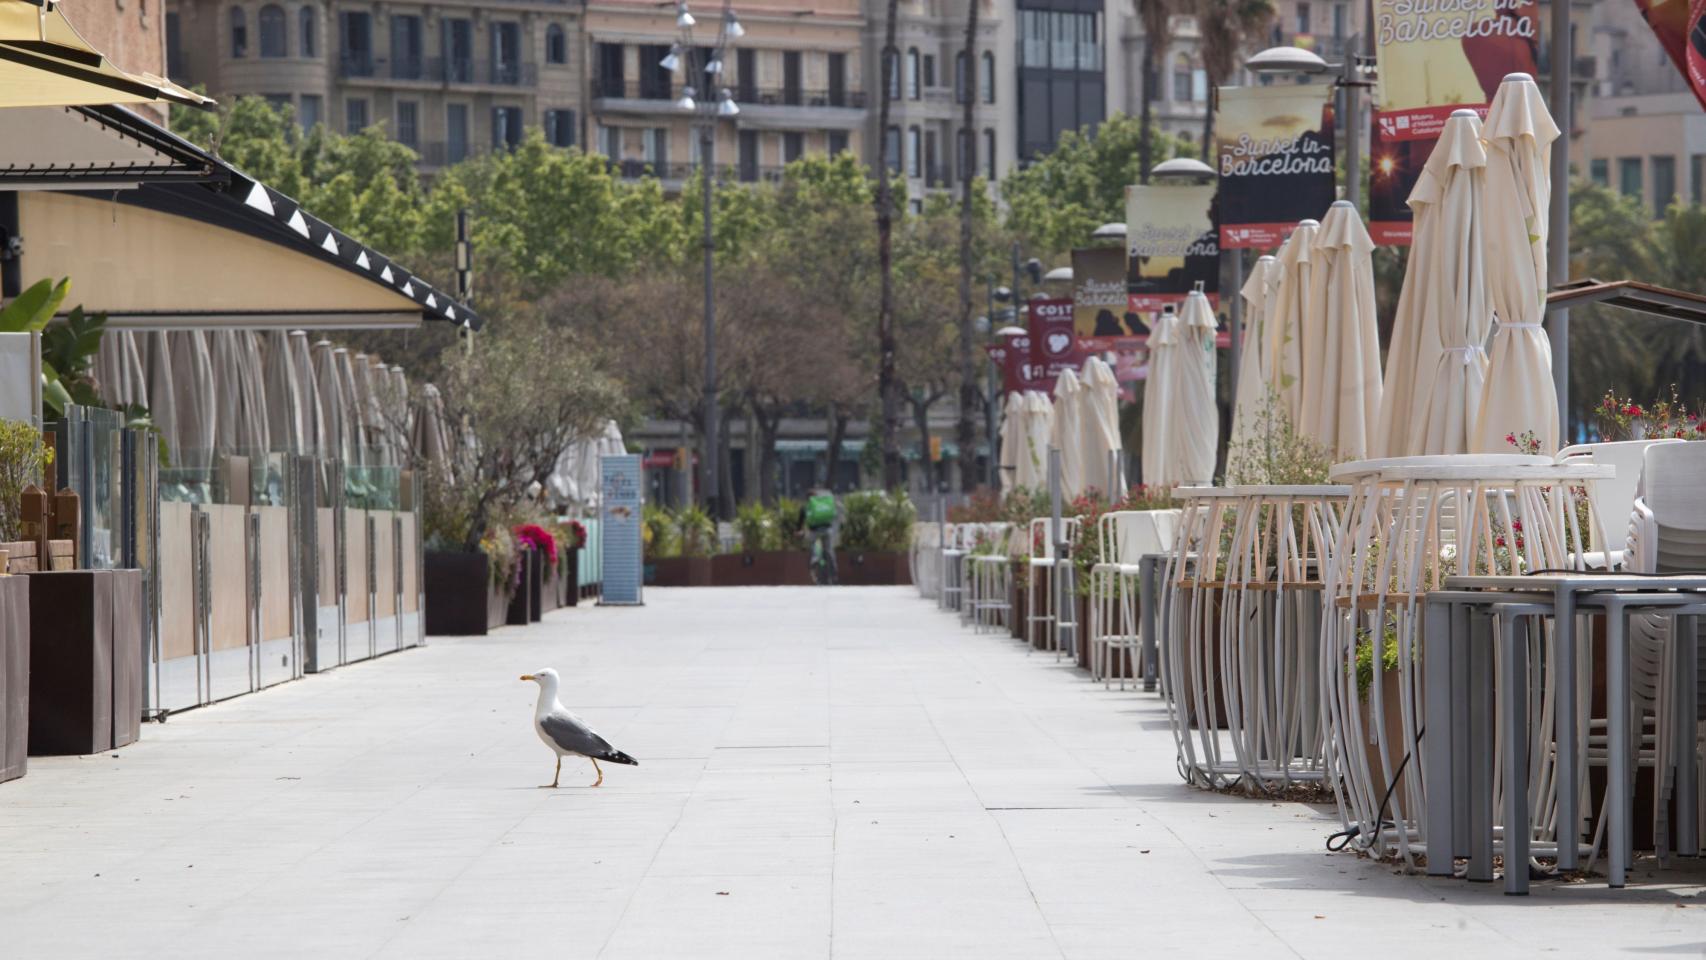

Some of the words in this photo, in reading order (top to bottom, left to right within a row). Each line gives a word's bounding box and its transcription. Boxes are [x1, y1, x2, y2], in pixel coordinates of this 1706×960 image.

[1378, 11, 1535, 46] Barcelona
[1233, 133, 1299, 156] Sunset
[1302, 137, 1321, 154] in
[1221, 154, 1334, 177] Barcelona
[1128, 240, 1218, 257] Barcelona
